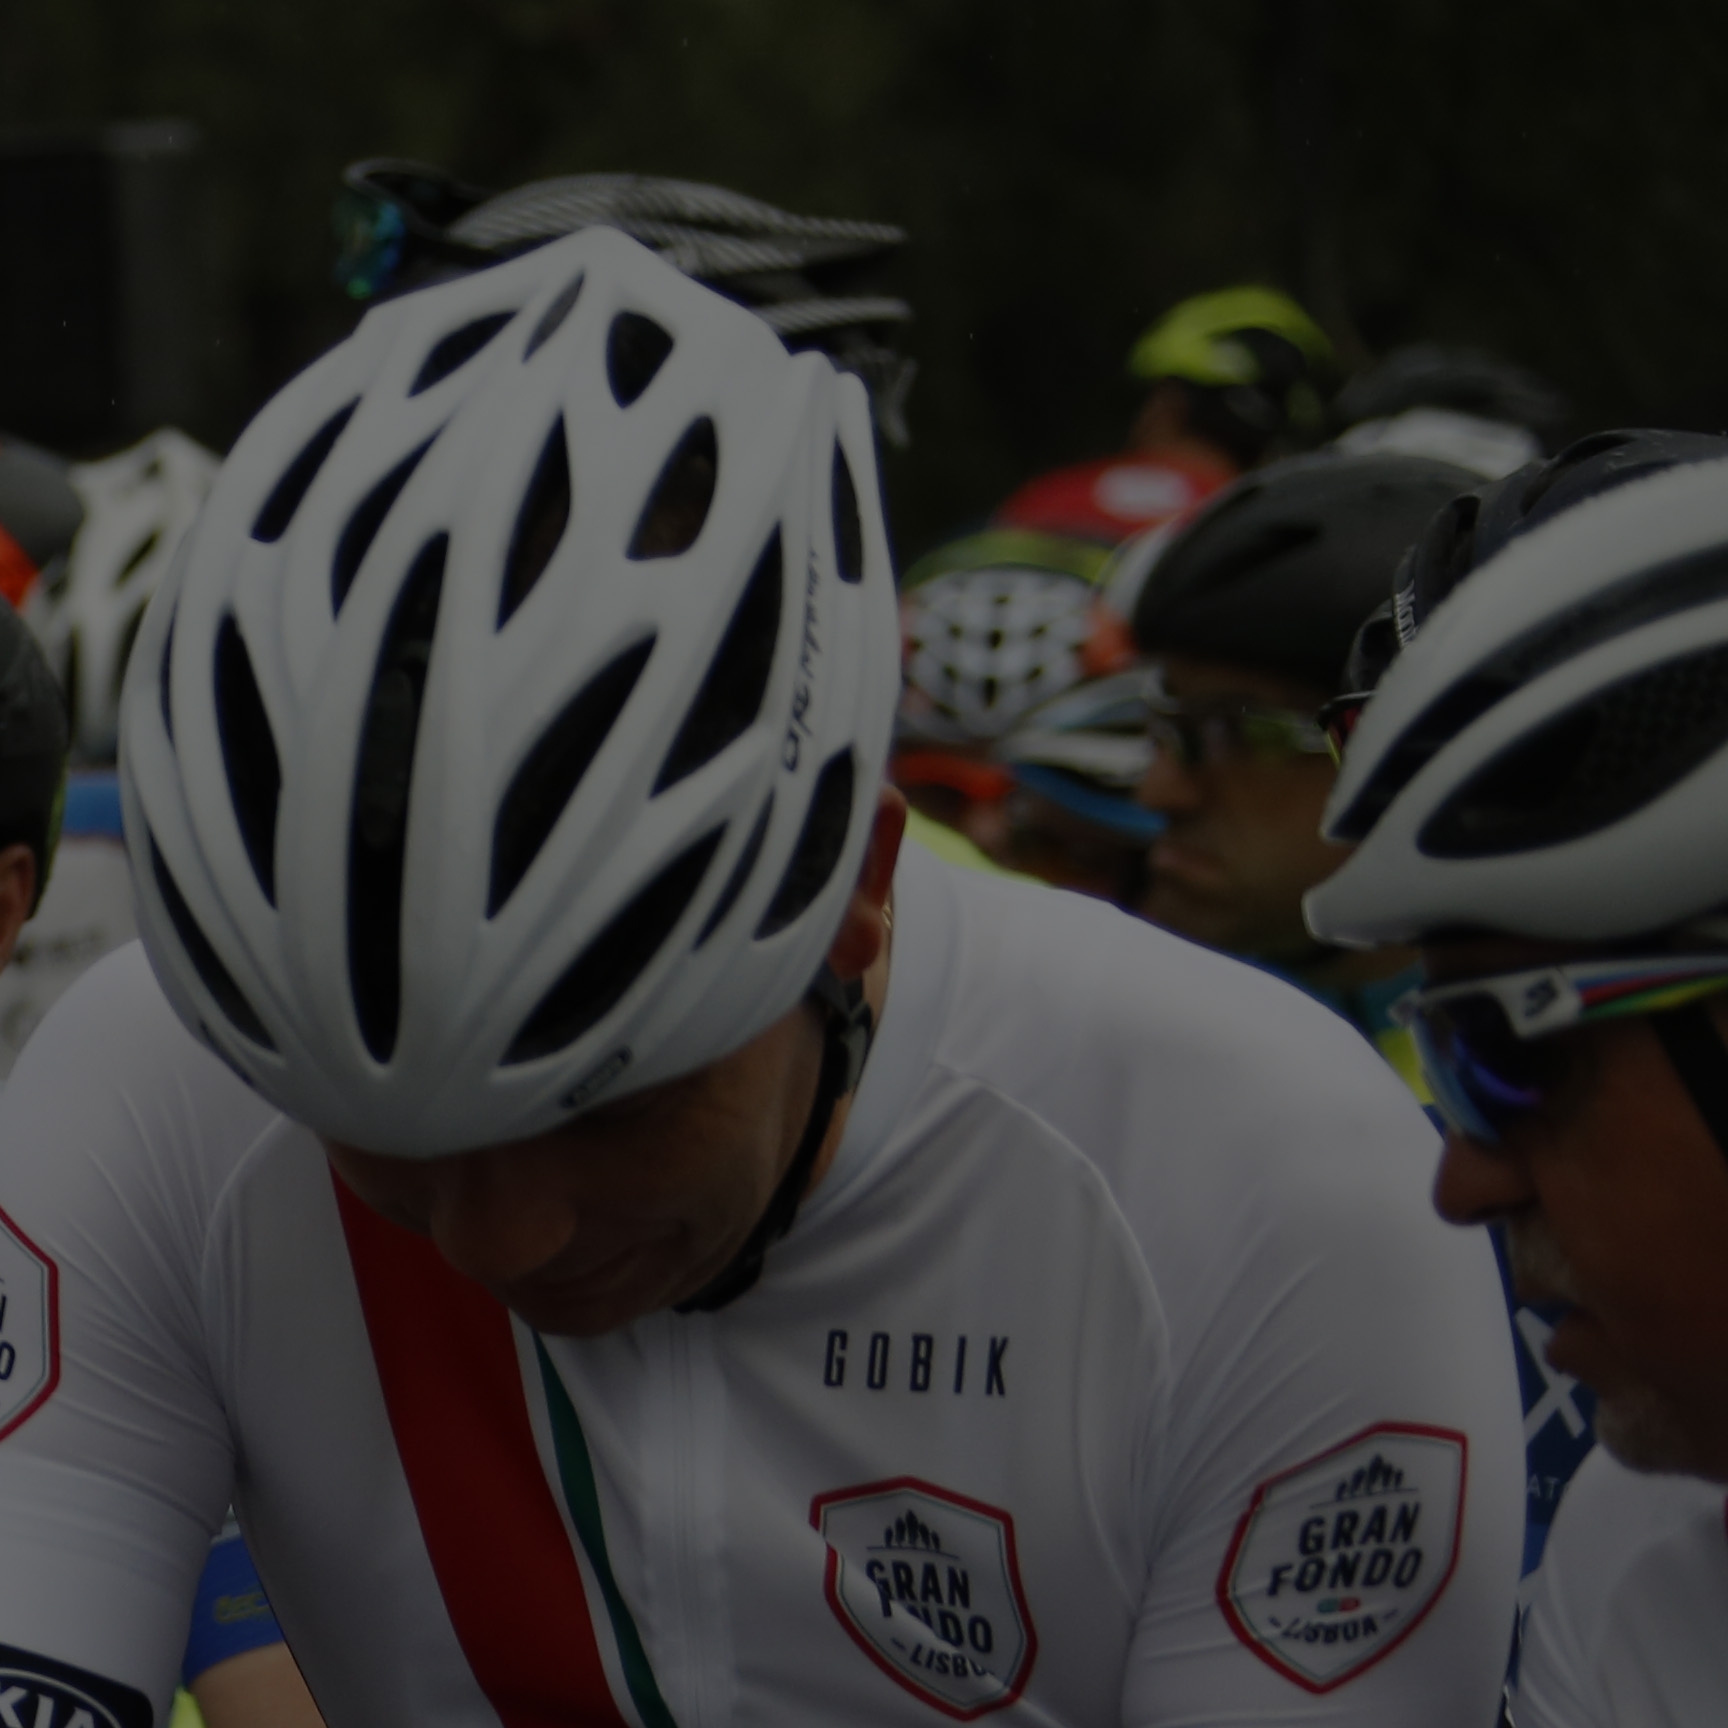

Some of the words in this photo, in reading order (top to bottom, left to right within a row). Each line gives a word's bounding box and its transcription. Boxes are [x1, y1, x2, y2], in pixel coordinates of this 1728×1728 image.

[825, 1329, 1010, 1398] GOBIK
[1299, 1502, 1420, 1556] GRAN
[1267, 1548, 1422, 1597] FONDO
